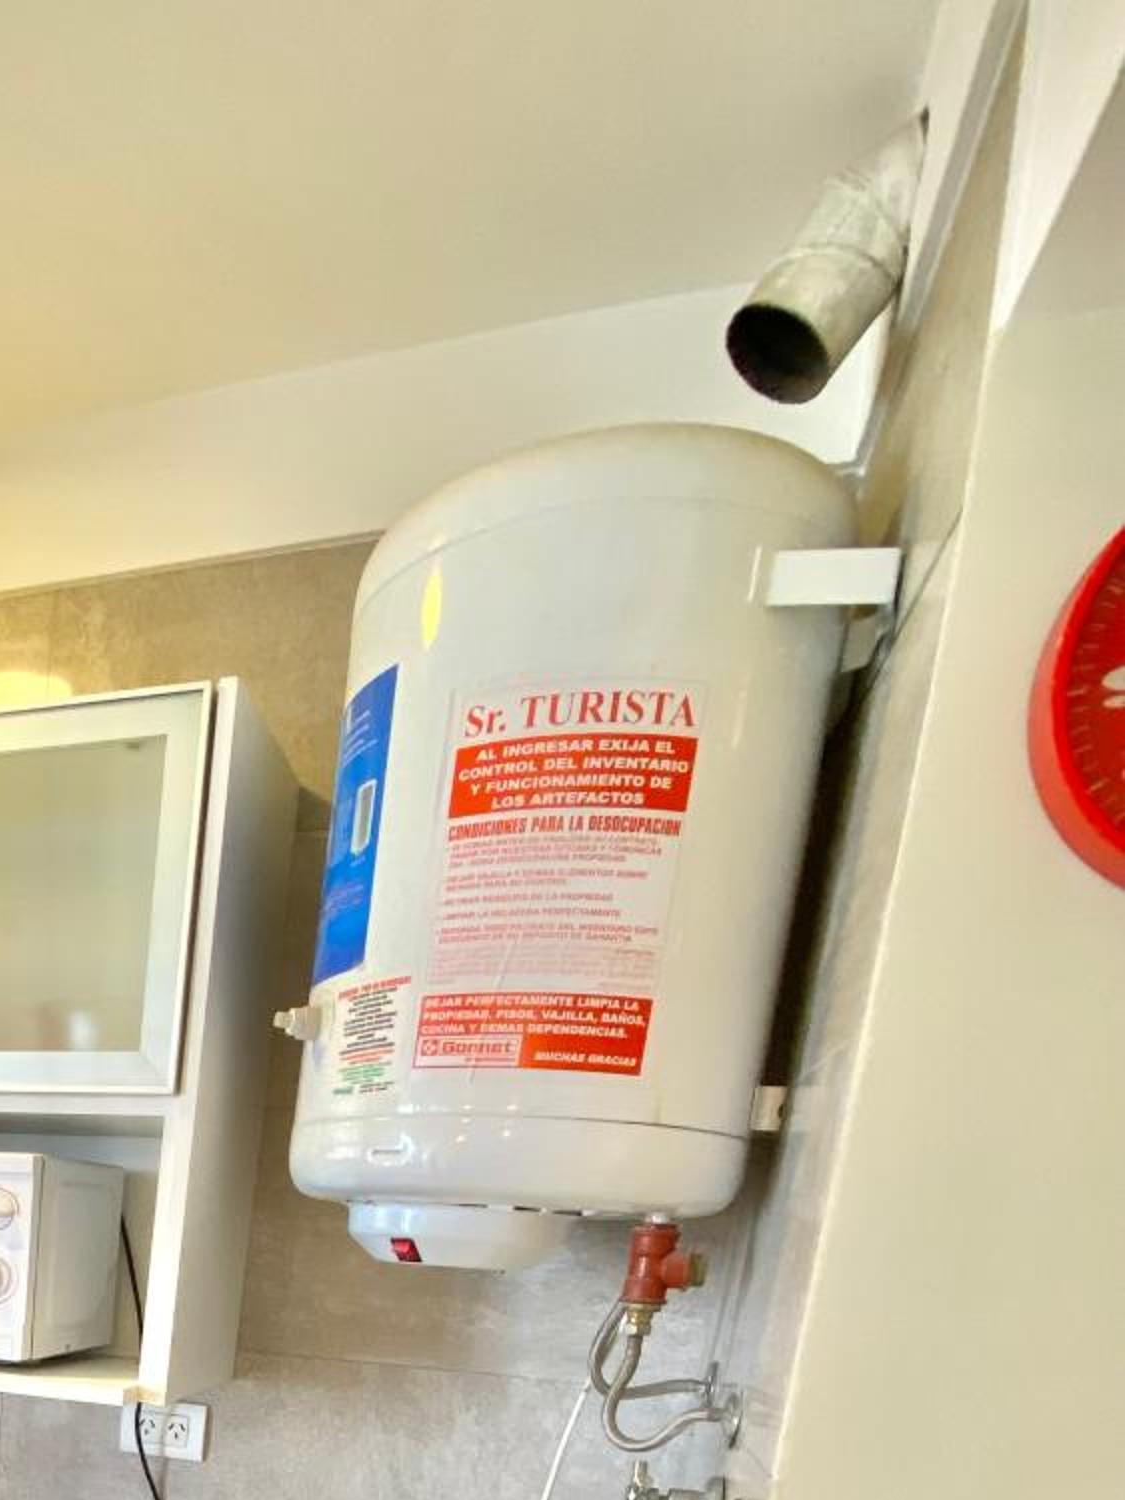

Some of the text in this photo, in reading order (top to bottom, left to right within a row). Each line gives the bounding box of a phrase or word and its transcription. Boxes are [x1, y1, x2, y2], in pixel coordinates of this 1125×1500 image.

[464, 690, 695, 739] Sr. TURISTA
[476, 739, 676, 761] AL INGRESAR EXIJA EL
[458, 757, 689, 782] CONTROL DEL INVENTARIO
[470, 773, 672, 796] Y FUNCIONAMIENTO DE
[491, 791, 645, 809] LOS ARTEFACTOS
[448, 816, 682, 841] CONDICIONES PARA LA DESOCUPACION
[468, 995, 574, 1007] PERFECTAMENTE
[577, 997, 620, 1009] LIMPIA
[624, 1000, 640, 1011] LA
[469, 1024, 479, 1033] Y
[542, 1010, 597, 1023] VAJILLA,
[602, 1010, 646, 1027] BAÑOS,
[535, 1051, 636, 1067] MUCHAS GRACIAS
